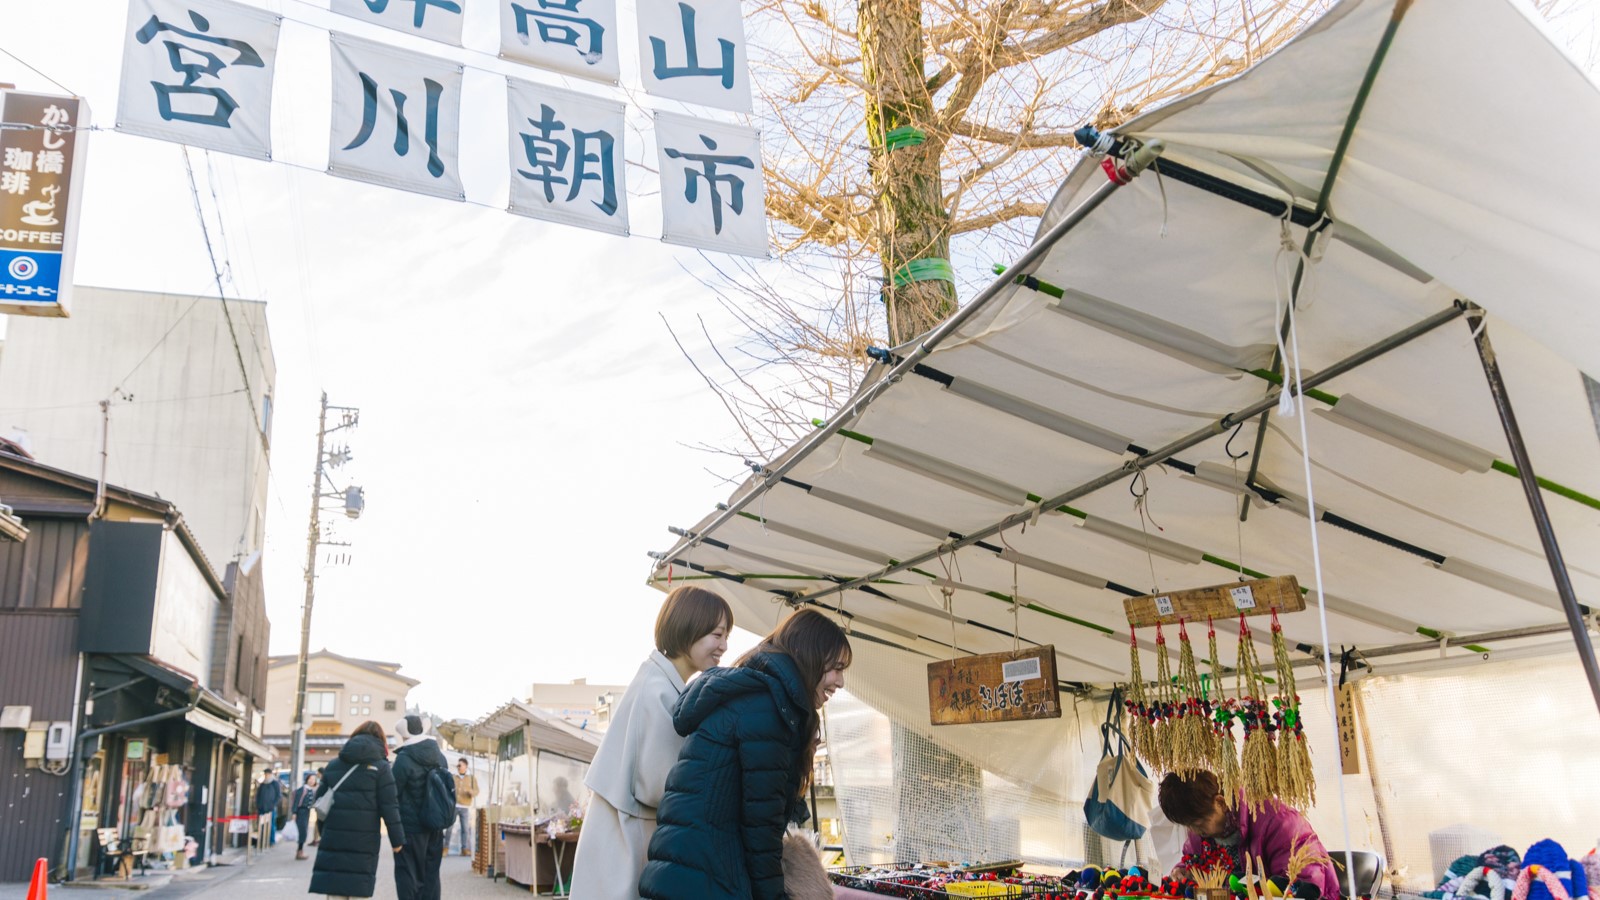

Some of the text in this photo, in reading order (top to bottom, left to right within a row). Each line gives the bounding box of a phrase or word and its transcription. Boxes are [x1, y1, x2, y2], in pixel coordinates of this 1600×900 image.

[1, 147, 33, 195] 珈琲
[135, 9, 755, 235] 宮川朝市
